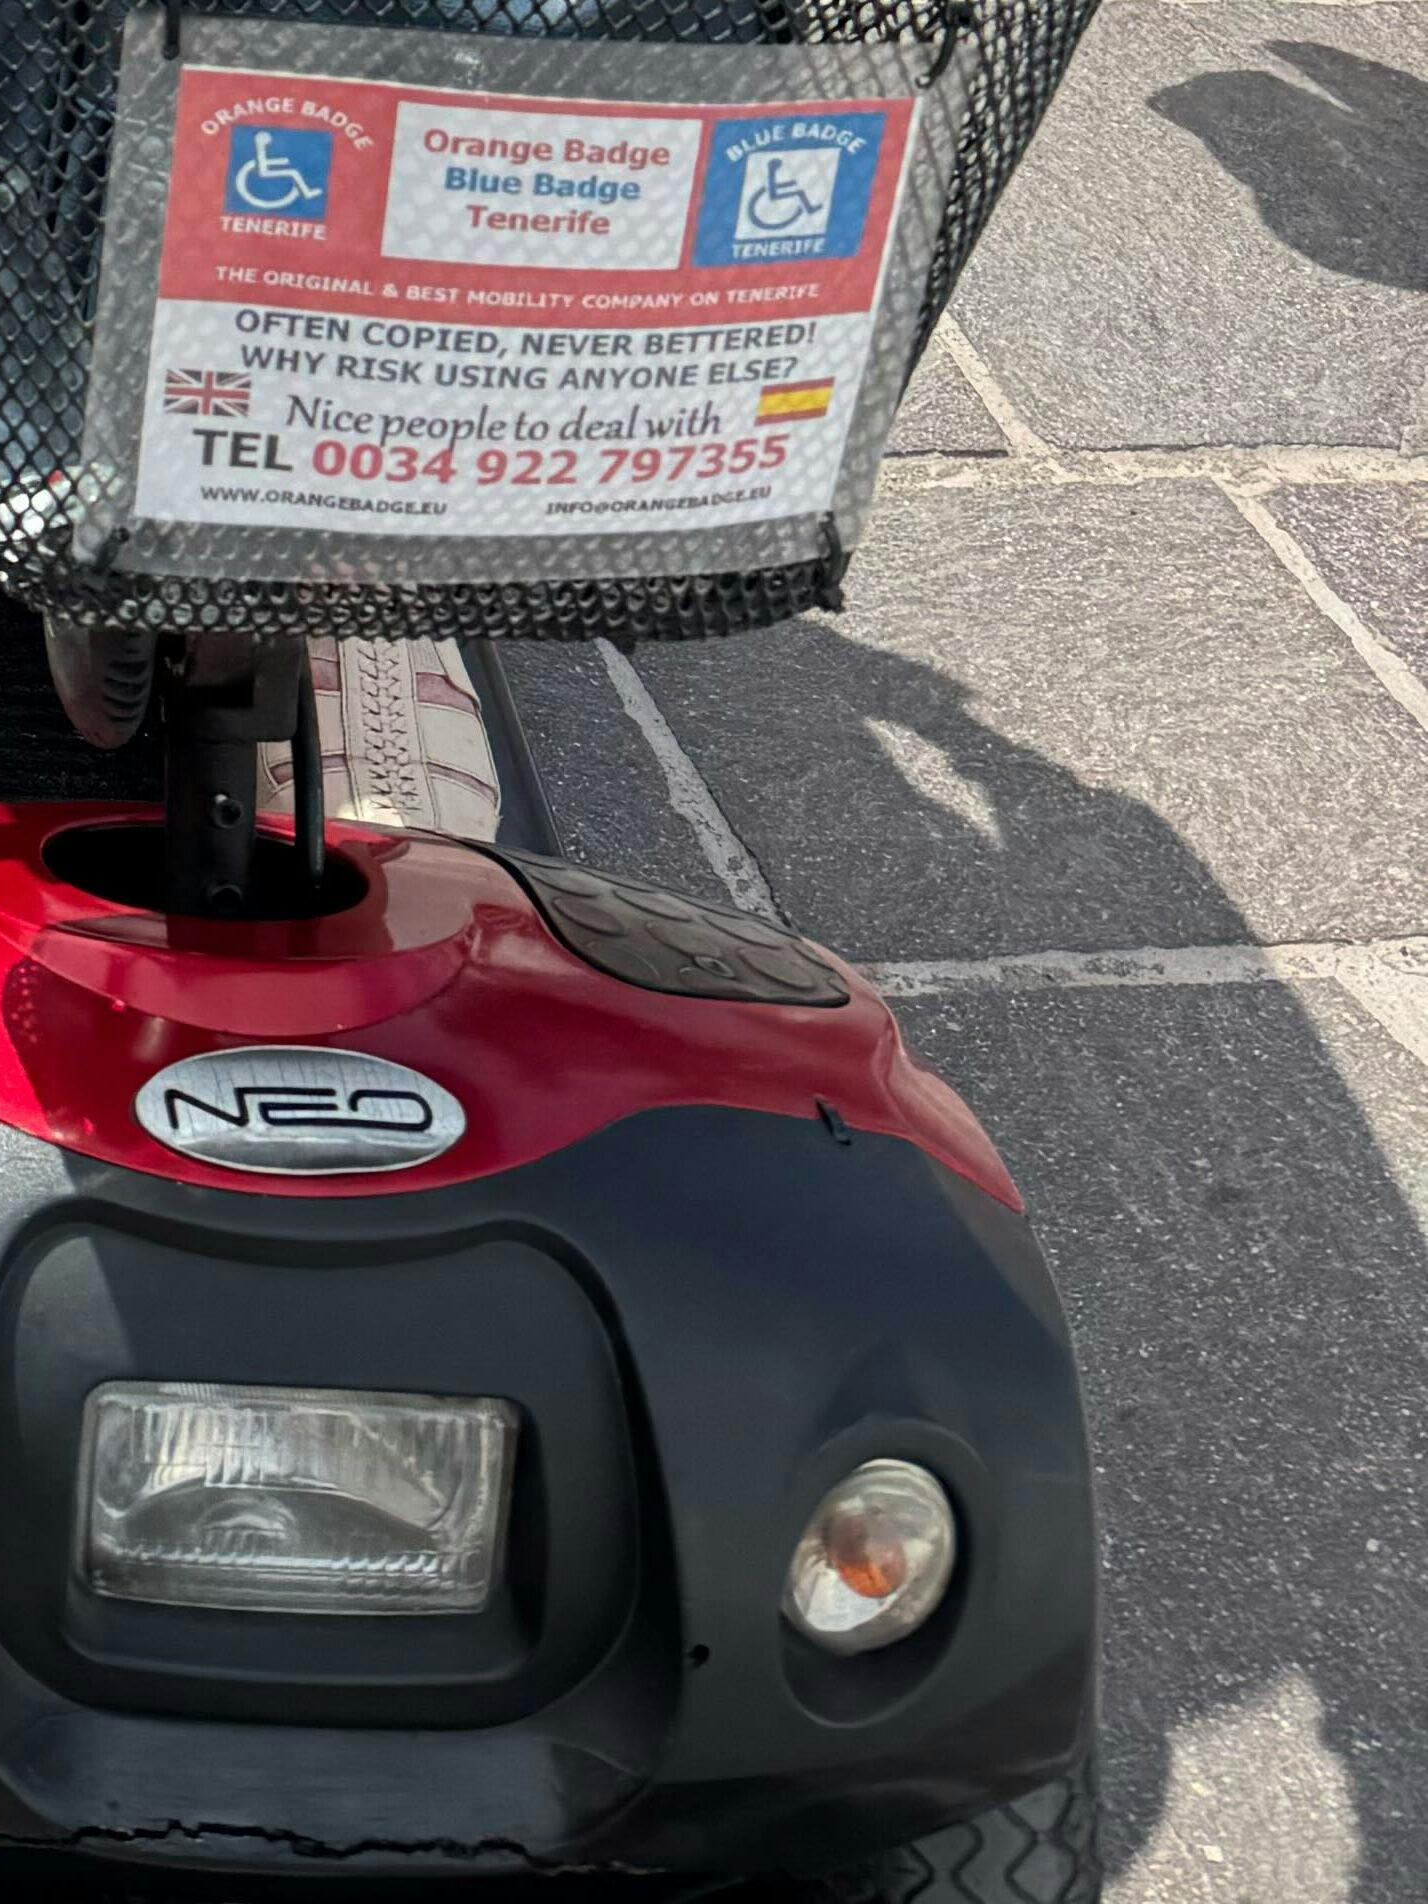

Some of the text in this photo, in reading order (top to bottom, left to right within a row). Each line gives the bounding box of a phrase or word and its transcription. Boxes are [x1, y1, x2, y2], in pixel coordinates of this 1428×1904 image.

[200, 97, 374, 150] ORANGE BADGE
[726, 122, 867, 162] BLUE BADGE
[423, 128, 671, 170] Orange Badge
[444, 166, 641, 204] Blue Badge
[220, 216, 327, 240] TENERIFE
[465, 204, 611, 235] Tenerife
[732, 237, 826, 259] TENERIFE
[215, 266, 820, 309] THE ORIGINAL & BEST MOBILITY COMPANY ON TENERIFE
[235, 309, 818, 359] OFTEN COPIED, NEVER BETTERED!
[240, 344, 799, 390] WHY RISK USING ANYONE ELSE?
[285, 394, 721, 453] Nice people to deal with
[192, 427, 791, 485] TEL 0034 922 797355
[200, 486, 773, 515] WWW.ORANGEBADGE.EU INFO@ORANGEBADGE.EU
[164, 1086, 433, 1133] NEO
